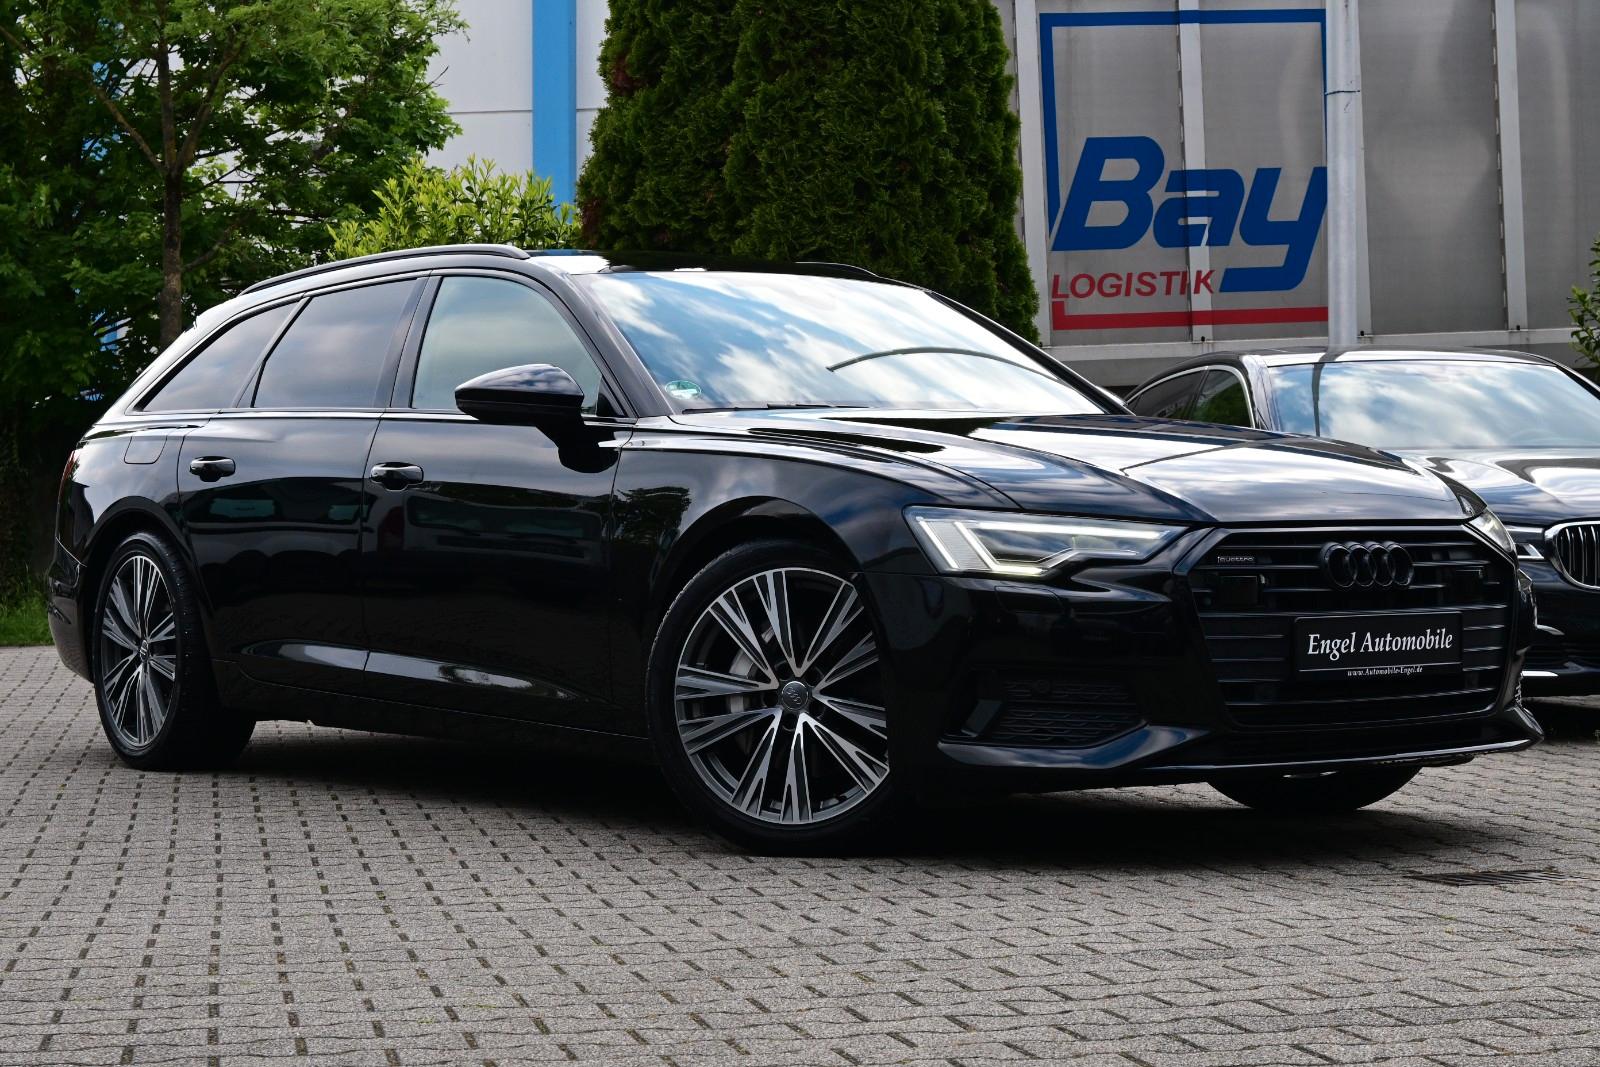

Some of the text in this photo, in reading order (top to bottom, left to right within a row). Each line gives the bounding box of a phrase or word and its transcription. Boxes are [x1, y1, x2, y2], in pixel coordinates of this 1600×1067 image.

[1051, 135, 1327, 292] Bay
[1051, 269, 1215, 299] LOGISTIK
[1307, 628, 1453, 661] Engel Automobile
[1347, 664, 1423, 677] www.Automobile-Engel.de
